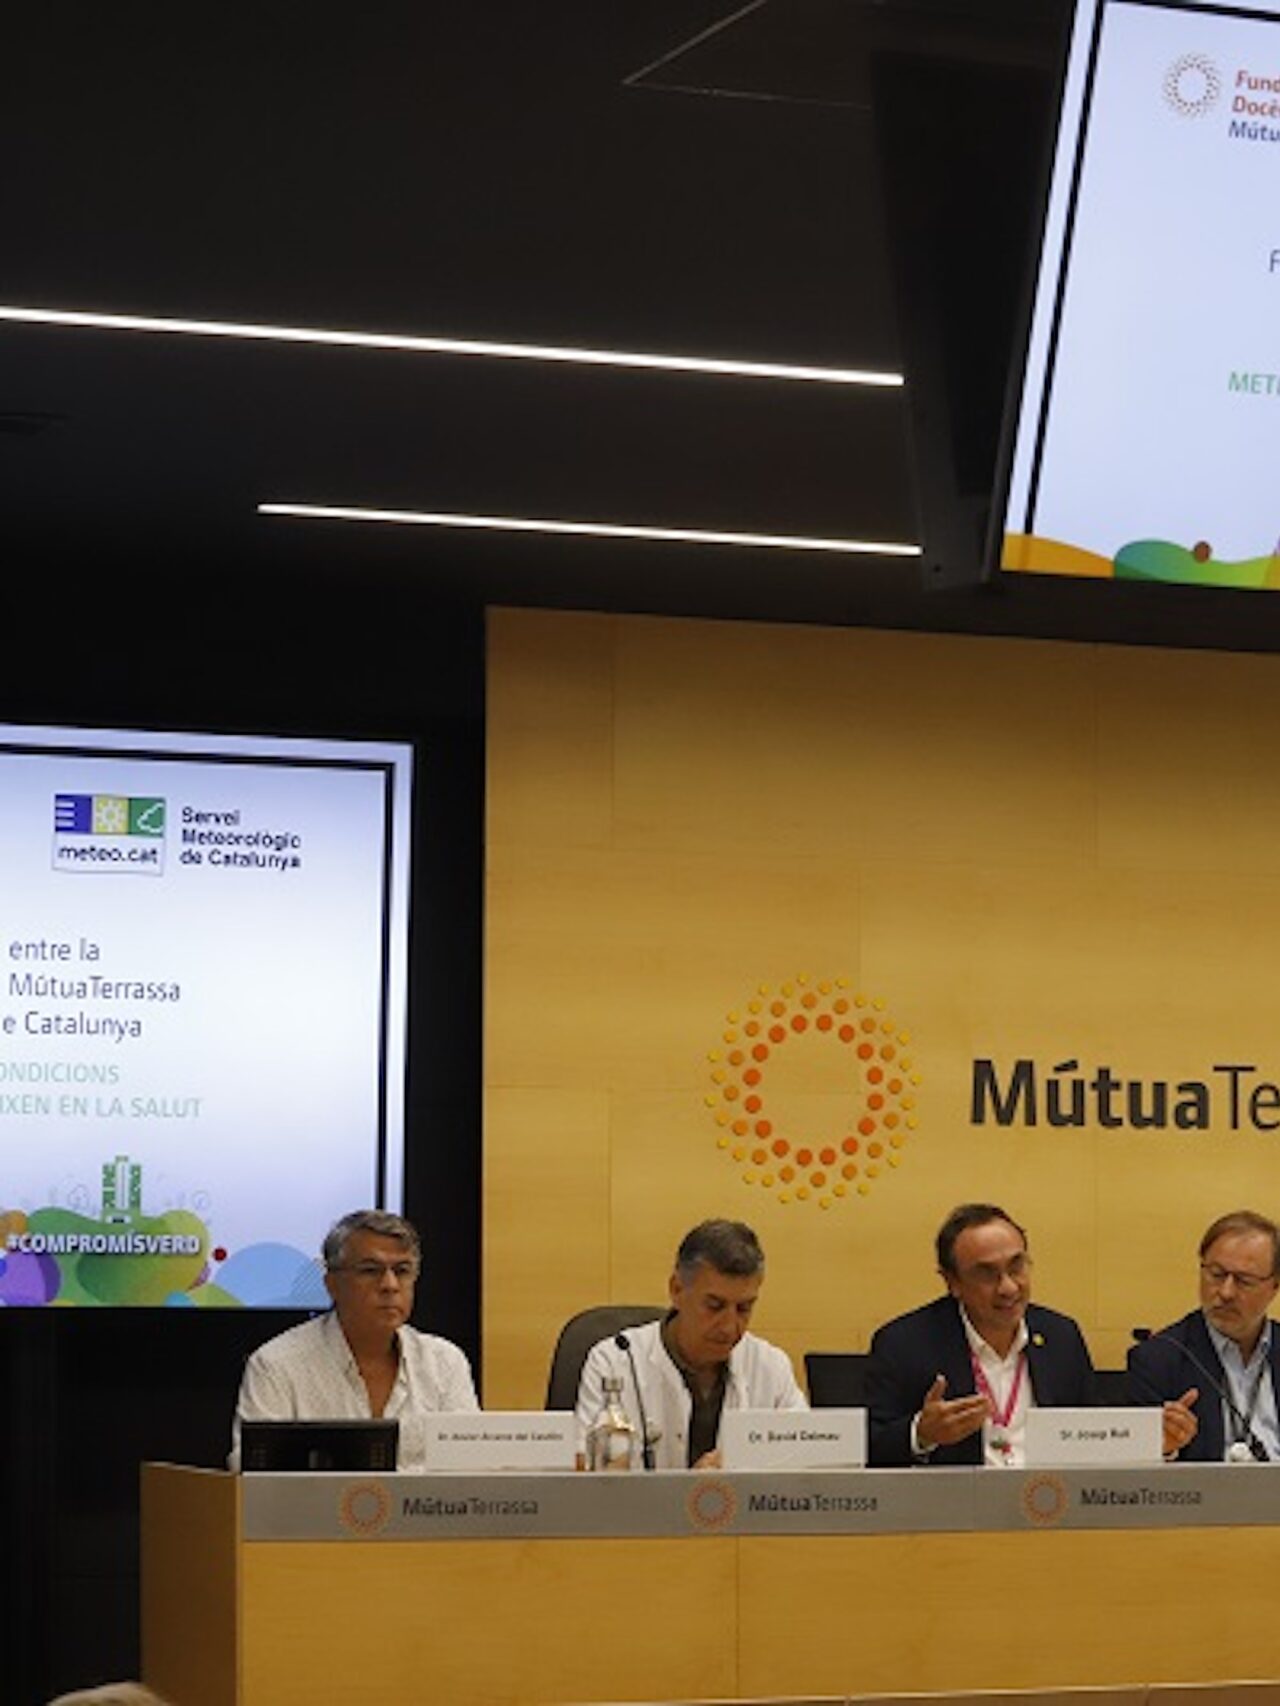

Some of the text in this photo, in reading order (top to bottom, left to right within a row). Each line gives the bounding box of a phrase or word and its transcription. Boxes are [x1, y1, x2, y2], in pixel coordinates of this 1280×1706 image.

[181, 808, 240, 825] Servei
[58, 845, 157, 864] meteo.cat
[179, 849, 301, 871] de Catalunya
[9, 938, 100, 961] entre la
[9, 973, 181, 1002] MútuaTerrassa
[25, 1011, 142, 1044] Catalunya
[59, 1094, 88, 1116] EN
[95, 1097, 125, 1118] LA
[130, 1097, 203, 1119] SALUT
[401, 1497, 539, 1516] MútuaTerrassa
[749, 1495, 879, 1512] MútuaTerrassa
[1080, 1487, 1202, 1506] MútuaTerrassa
